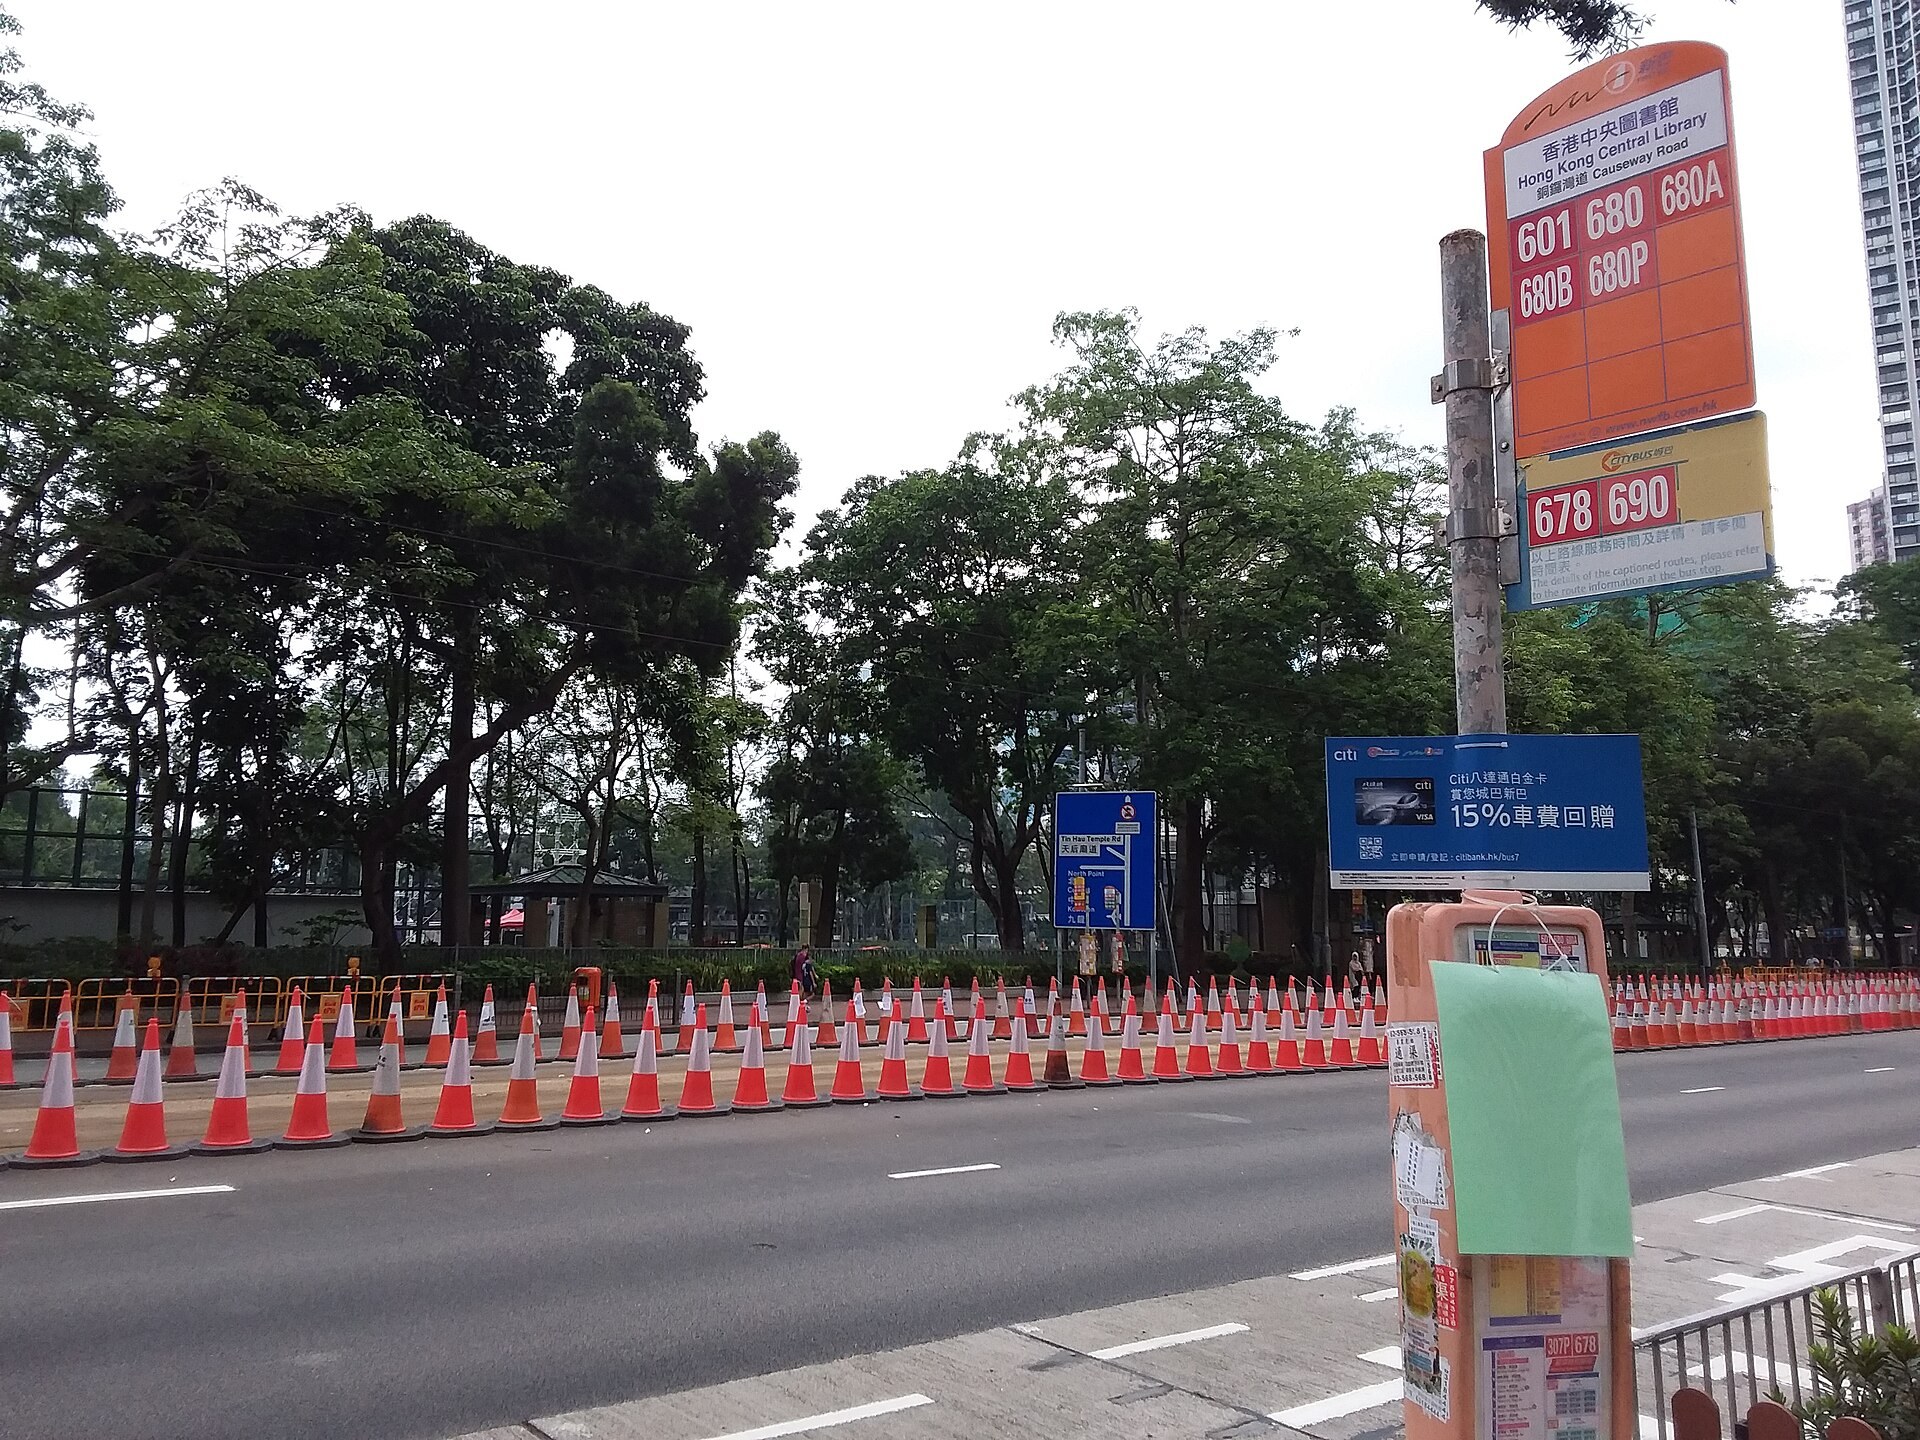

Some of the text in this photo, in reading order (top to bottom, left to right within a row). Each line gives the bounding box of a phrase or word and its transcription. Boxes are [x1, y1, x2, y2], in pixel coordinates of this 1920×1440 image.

[1542, 96, 1679, 163] 香港中央圖書館
[1518, 112, 1708, 190] Hong Kong Central Library
[1536, 137, 1689, 201] 銅鑼灣道 Causeway Road
[1517, 158, 1725, 263] 601 680 680A
[1519, 239, 1650, 318] 680B 680P
[1610, 448, 1653, 466] CITYBUS
[1534, 475, 1669, 538] 678 690
[1532, 578, 1549, 589] The
[1583, 570, 1593, 581] of
[1595, 568, 1611, 580] the
[1612, 559, 1661, 578] captioned
[1663, 555, 1698, 569] routes,
[1700, 550, 1733, 565] please
[1735, 545, 1761, 557] refer
[1532, 563, 1726, 601] to the route information at the bus stop.
[1334, 748, 1358, 761] citi
[1414, 781, 1433, 791] citi
[1450, 787, 1529, 801] 賞您城巴新巴
[1415, 813, 1434, 821] VISA
[1451, 803, 1615, 829] 15%車費回贈
[1455, 852, 1521, 862] citibank.hk/bus7
[1547, 1337, 1570, 1355] 307P
[1574, 1335, 1597, 1354] 678
